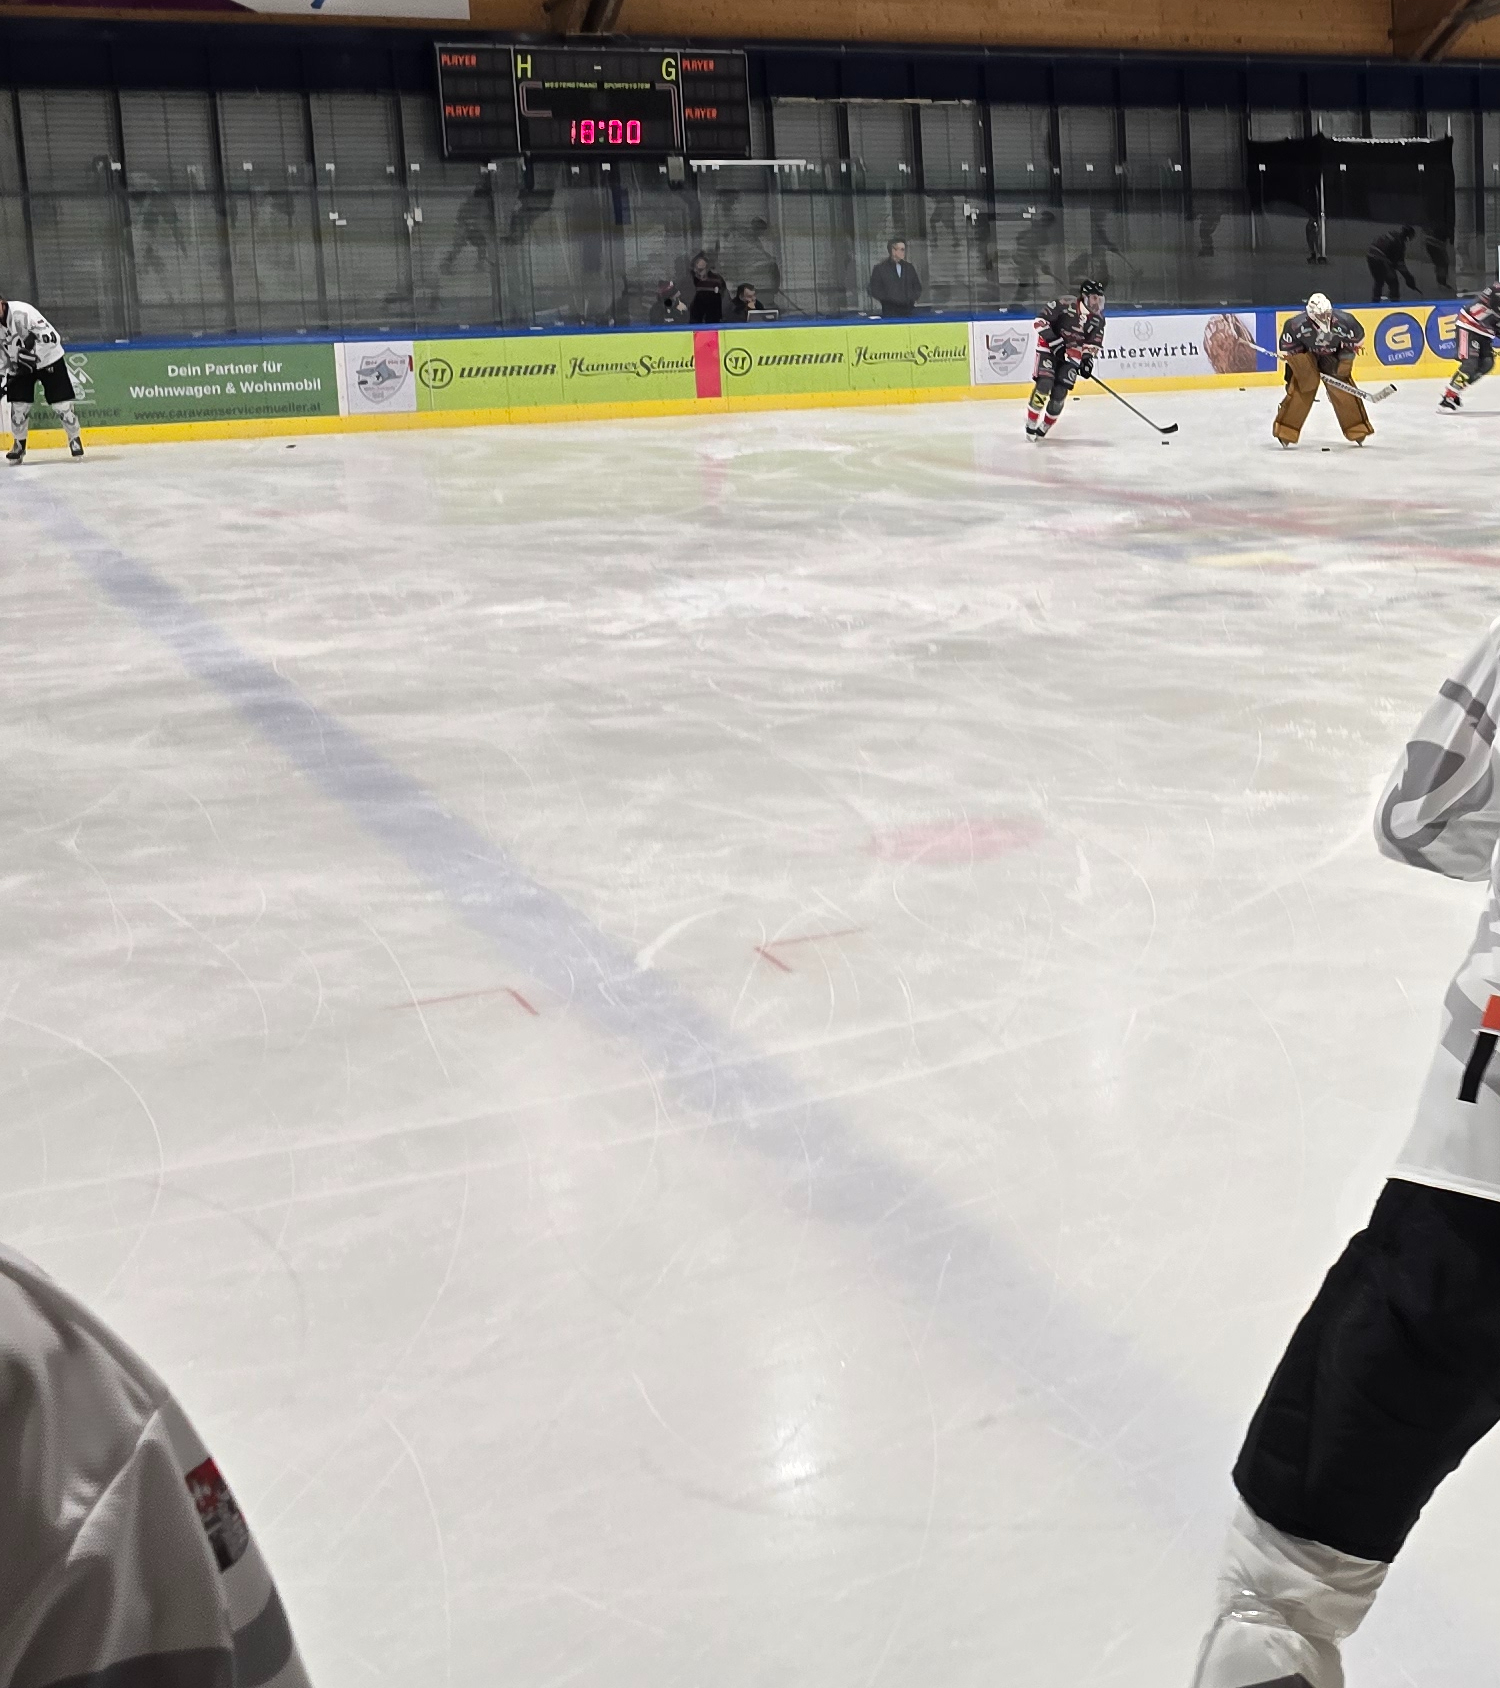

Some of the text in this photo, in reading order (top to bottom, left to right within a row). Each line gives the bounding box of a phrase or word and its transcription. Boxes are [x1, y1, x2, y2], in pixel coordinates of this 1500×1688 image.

[441, 54, 477, 67] PLAYER
[517, 54, 532, 79] H
[682, 59, 715, 72] PLAYER
[661, 57, 676, 81] G
[445, 105, 481, 118] PLAYER
[685, 107, 717, 121] PLAYER
[571, 119, 641, 145] 18:00
[1385, 324, 1412, 350] G
[757, 352, 845, 367] WARRIOR
[167, 360, 283, 377] Dein Partner für
[459, 363, 557, 379] WARRIOR
[129, 378, 322, 399] Wohnwagen & Wohnmobil
